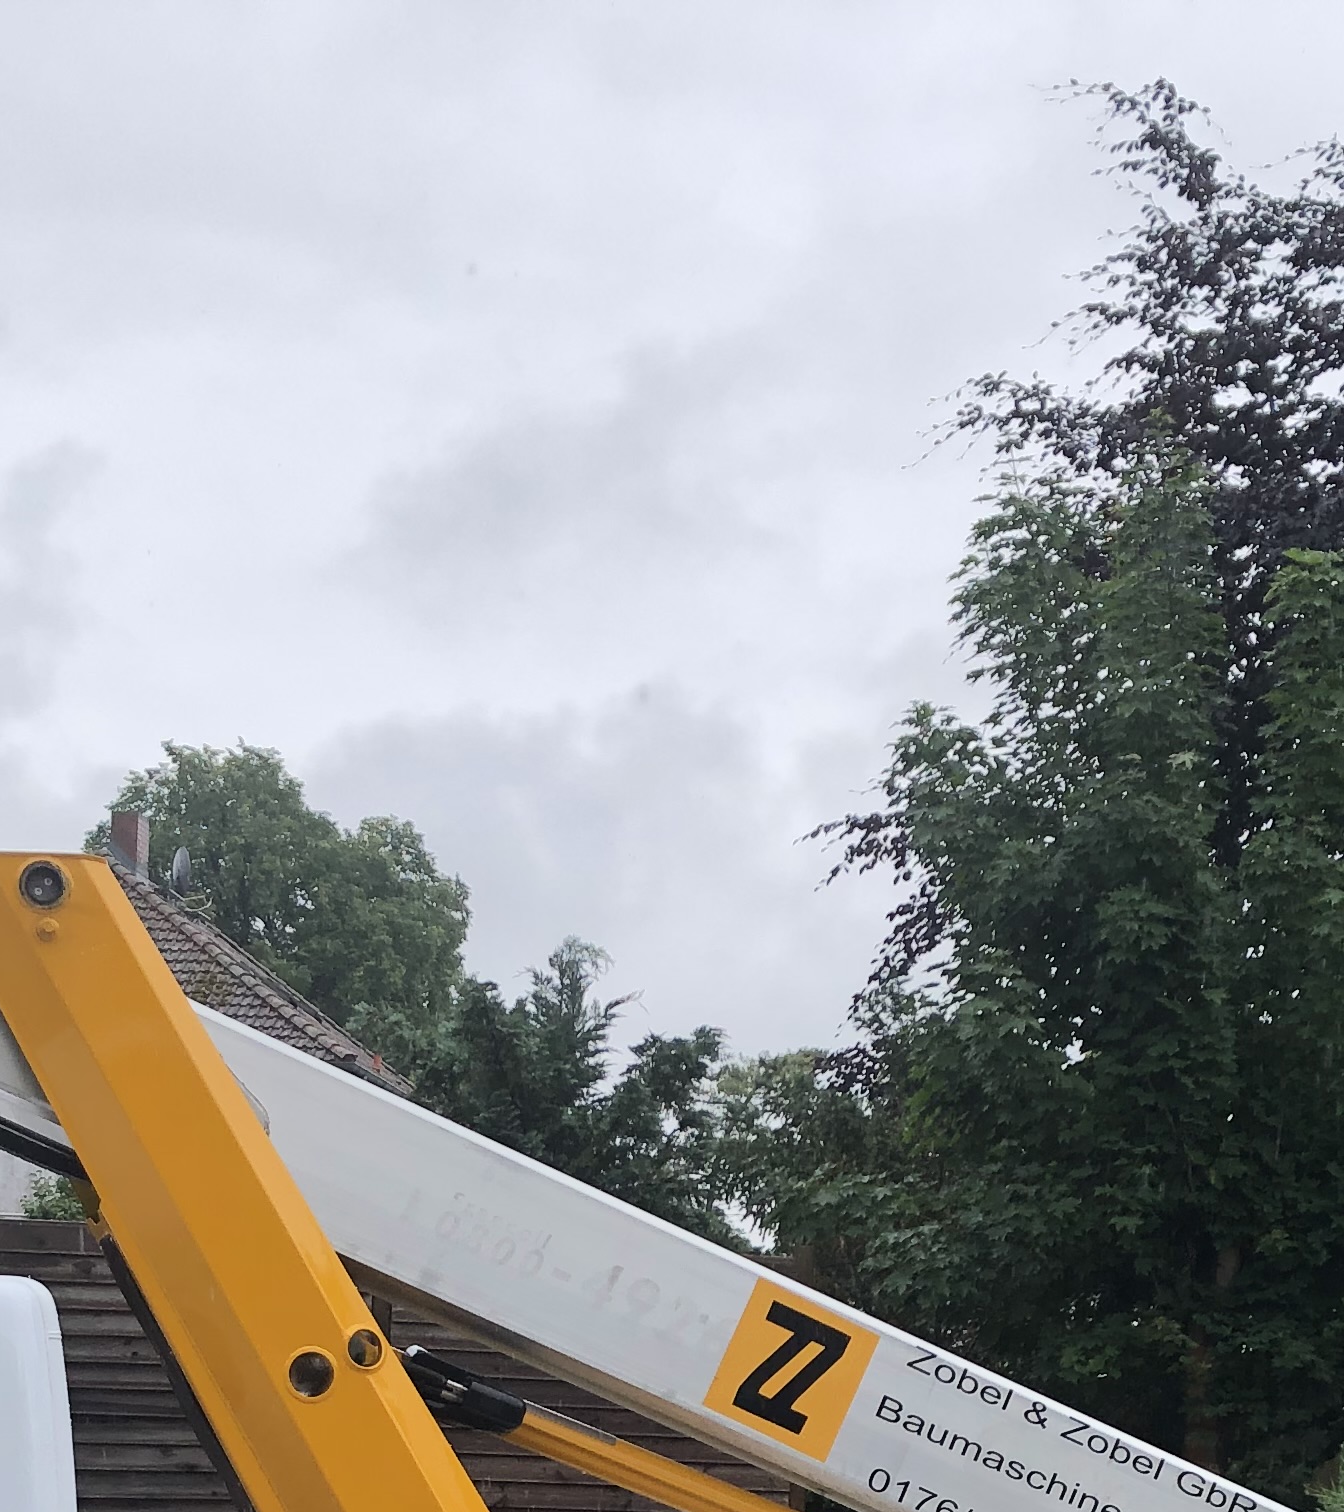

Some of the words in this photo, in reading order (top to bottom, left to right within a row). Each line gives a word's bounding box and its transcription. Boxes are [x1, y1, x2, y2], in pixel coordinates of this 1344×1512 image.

[906, 1345, 1014, 1412] Zobel
[1023, 1400, 1048, 1430] &
[1060, 1415, 1166, 1481] Zobel
